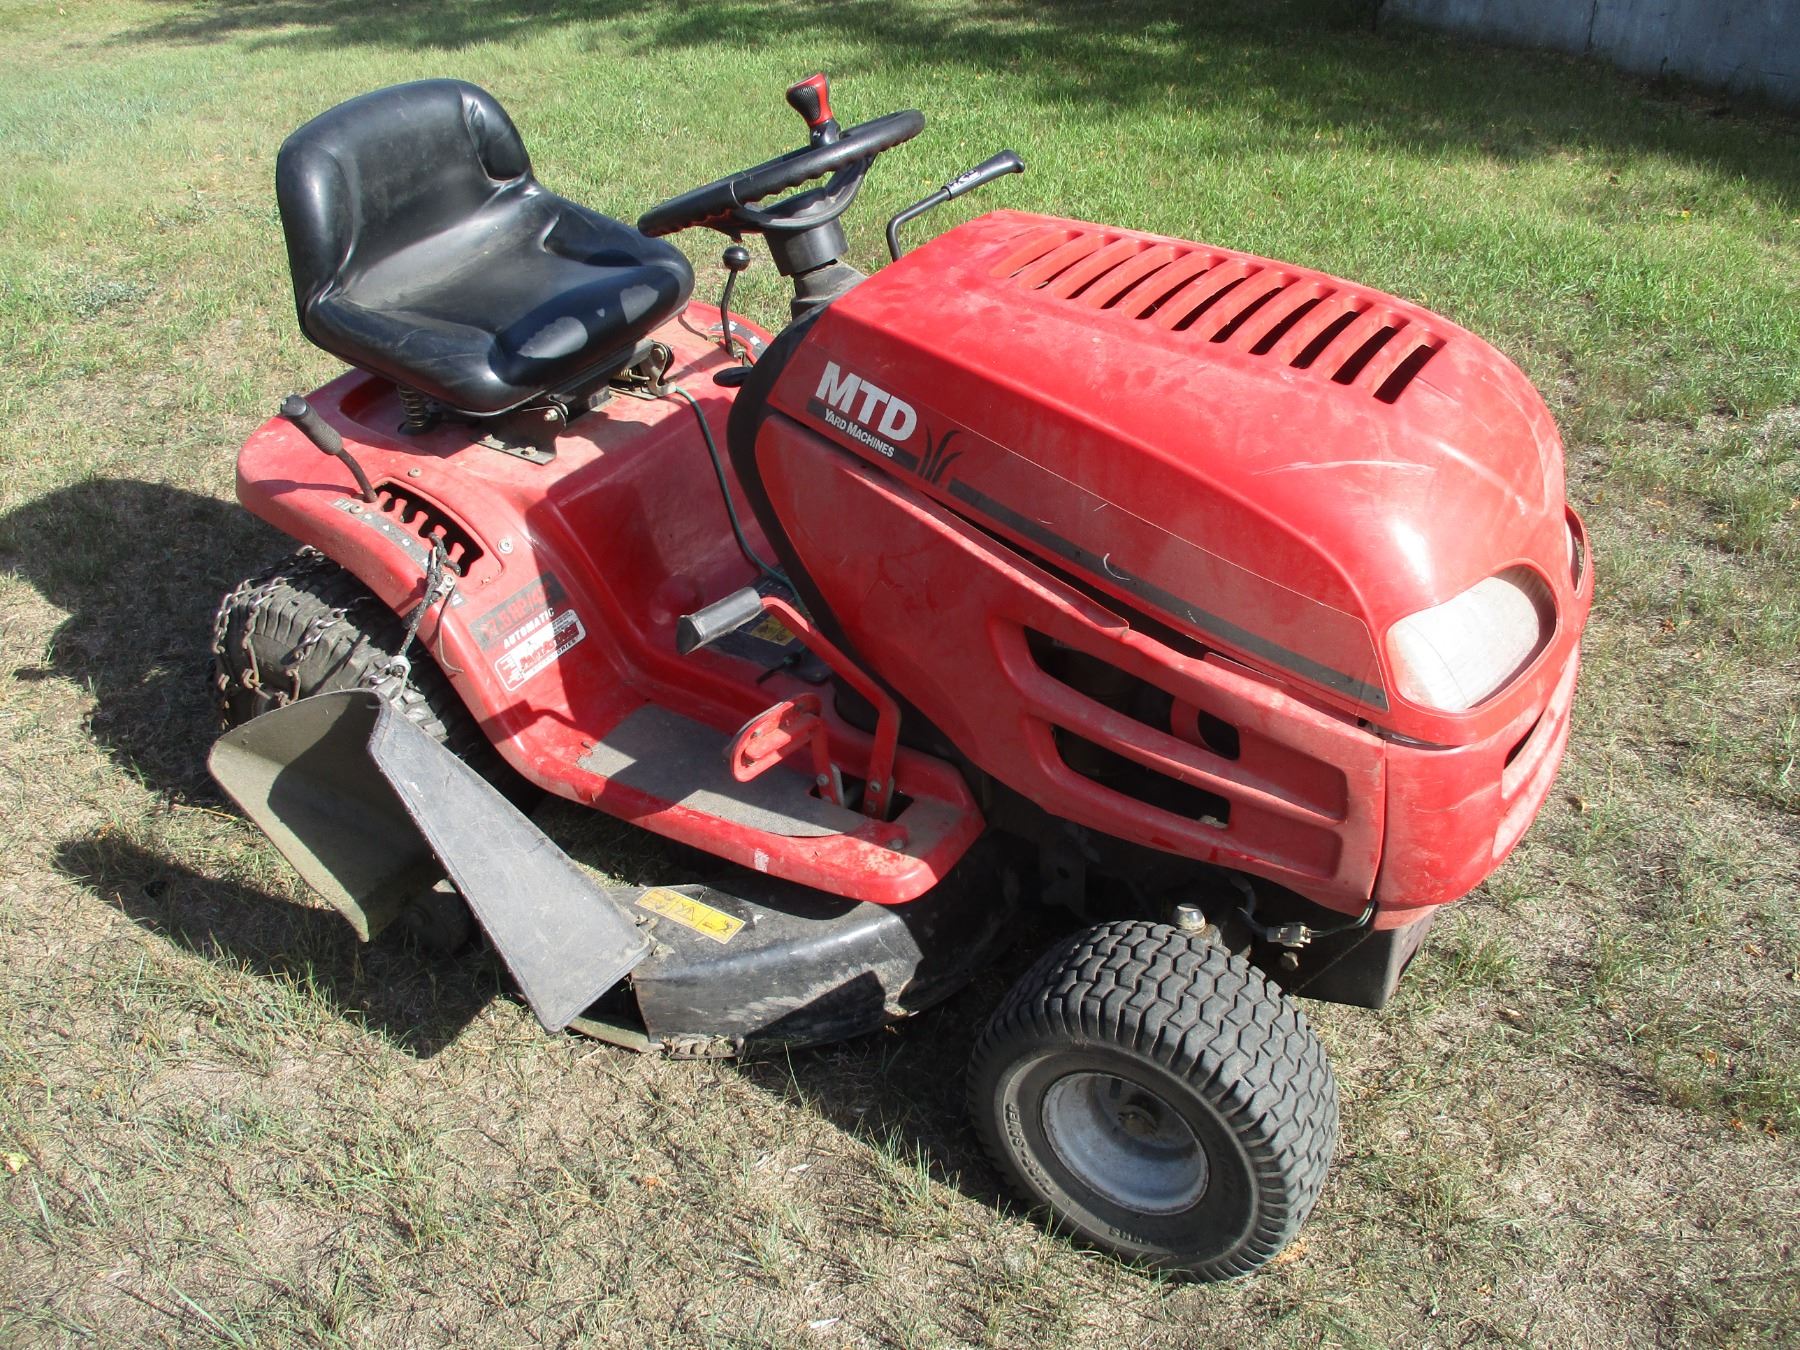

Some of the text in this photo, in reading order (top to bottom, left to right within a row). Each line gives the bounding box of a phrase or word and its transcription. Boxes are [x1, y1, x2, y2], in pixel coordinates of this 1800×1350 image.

[816, 360, 918, 441] MTD
[824, 408, 895, 458] YARD MACHINES
[503, 607, 555, 649] AUTOMATIC
